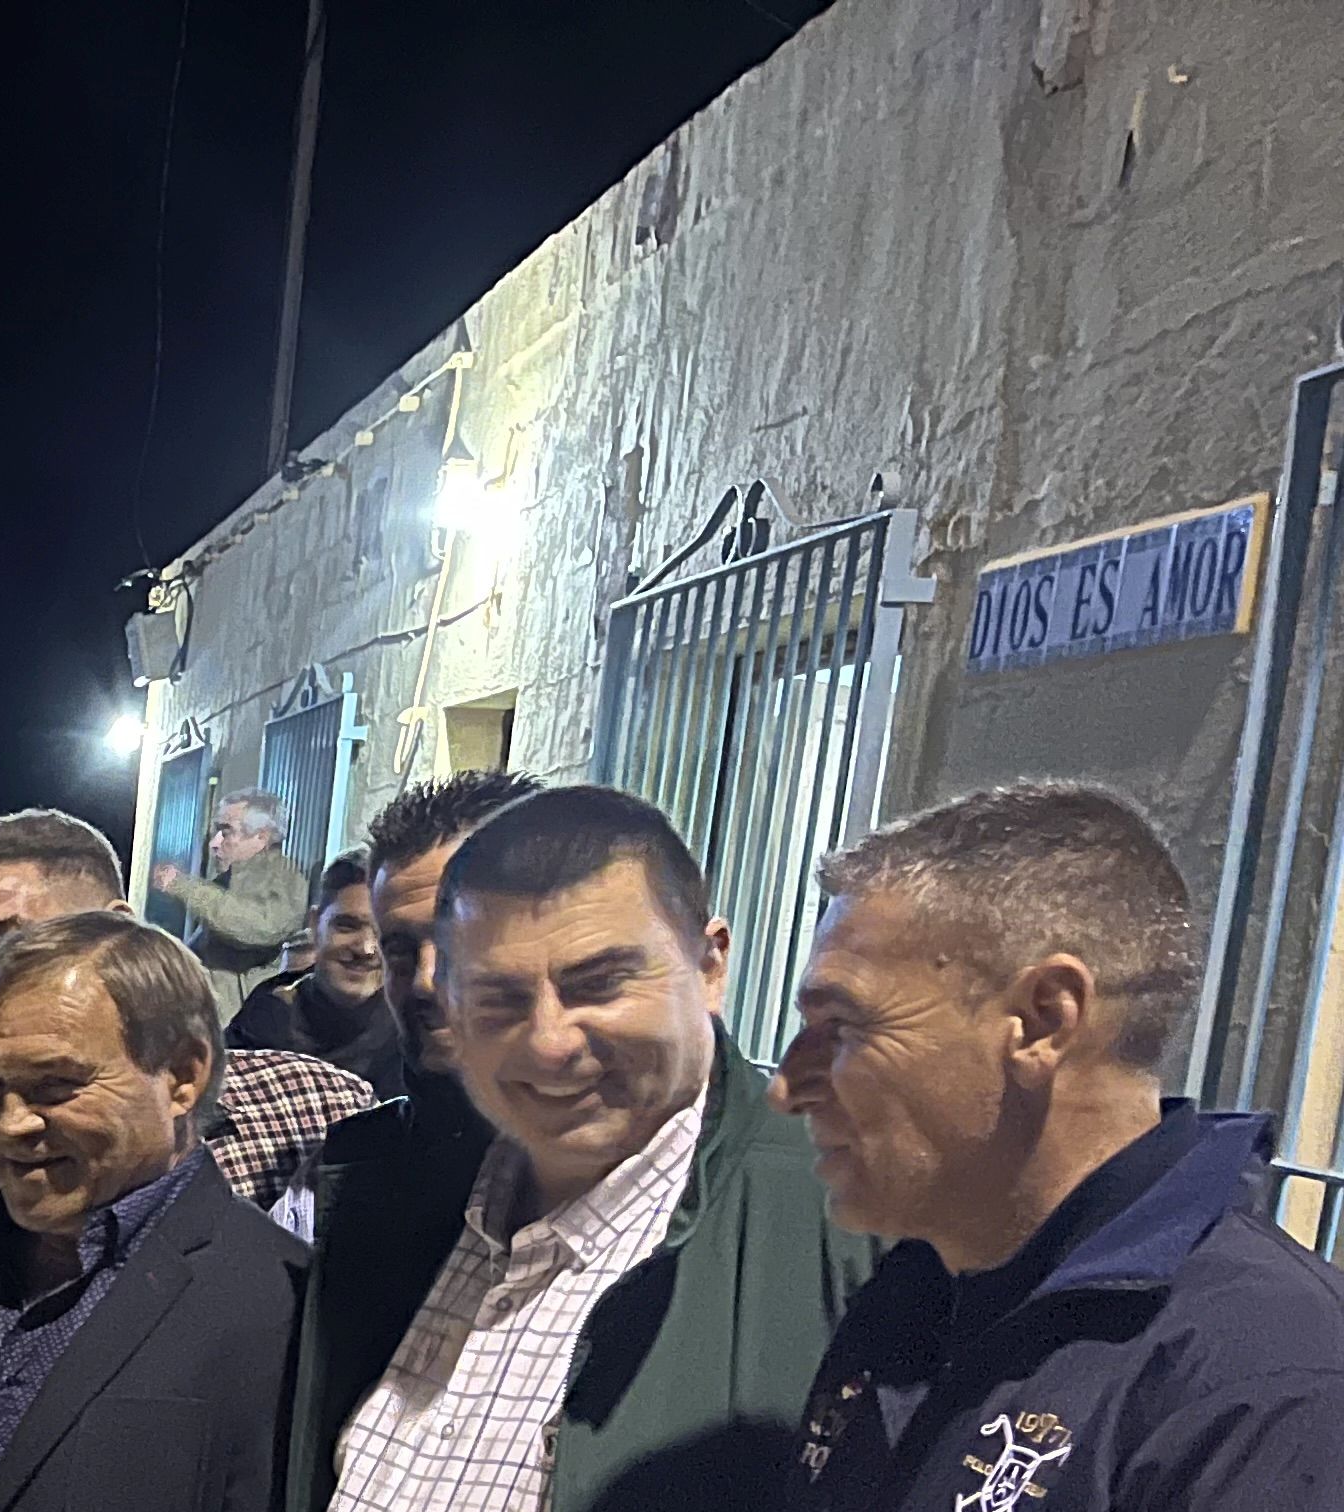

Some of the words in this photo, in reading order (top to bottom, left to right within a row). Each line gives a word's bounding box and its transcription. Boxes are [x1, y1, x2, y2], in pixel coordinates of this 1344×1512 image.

[969, 574, 1054, 660] DIOS
[1070, 558, 1120, 640] ES
[1141, 530, 1247, 628] AMOR
